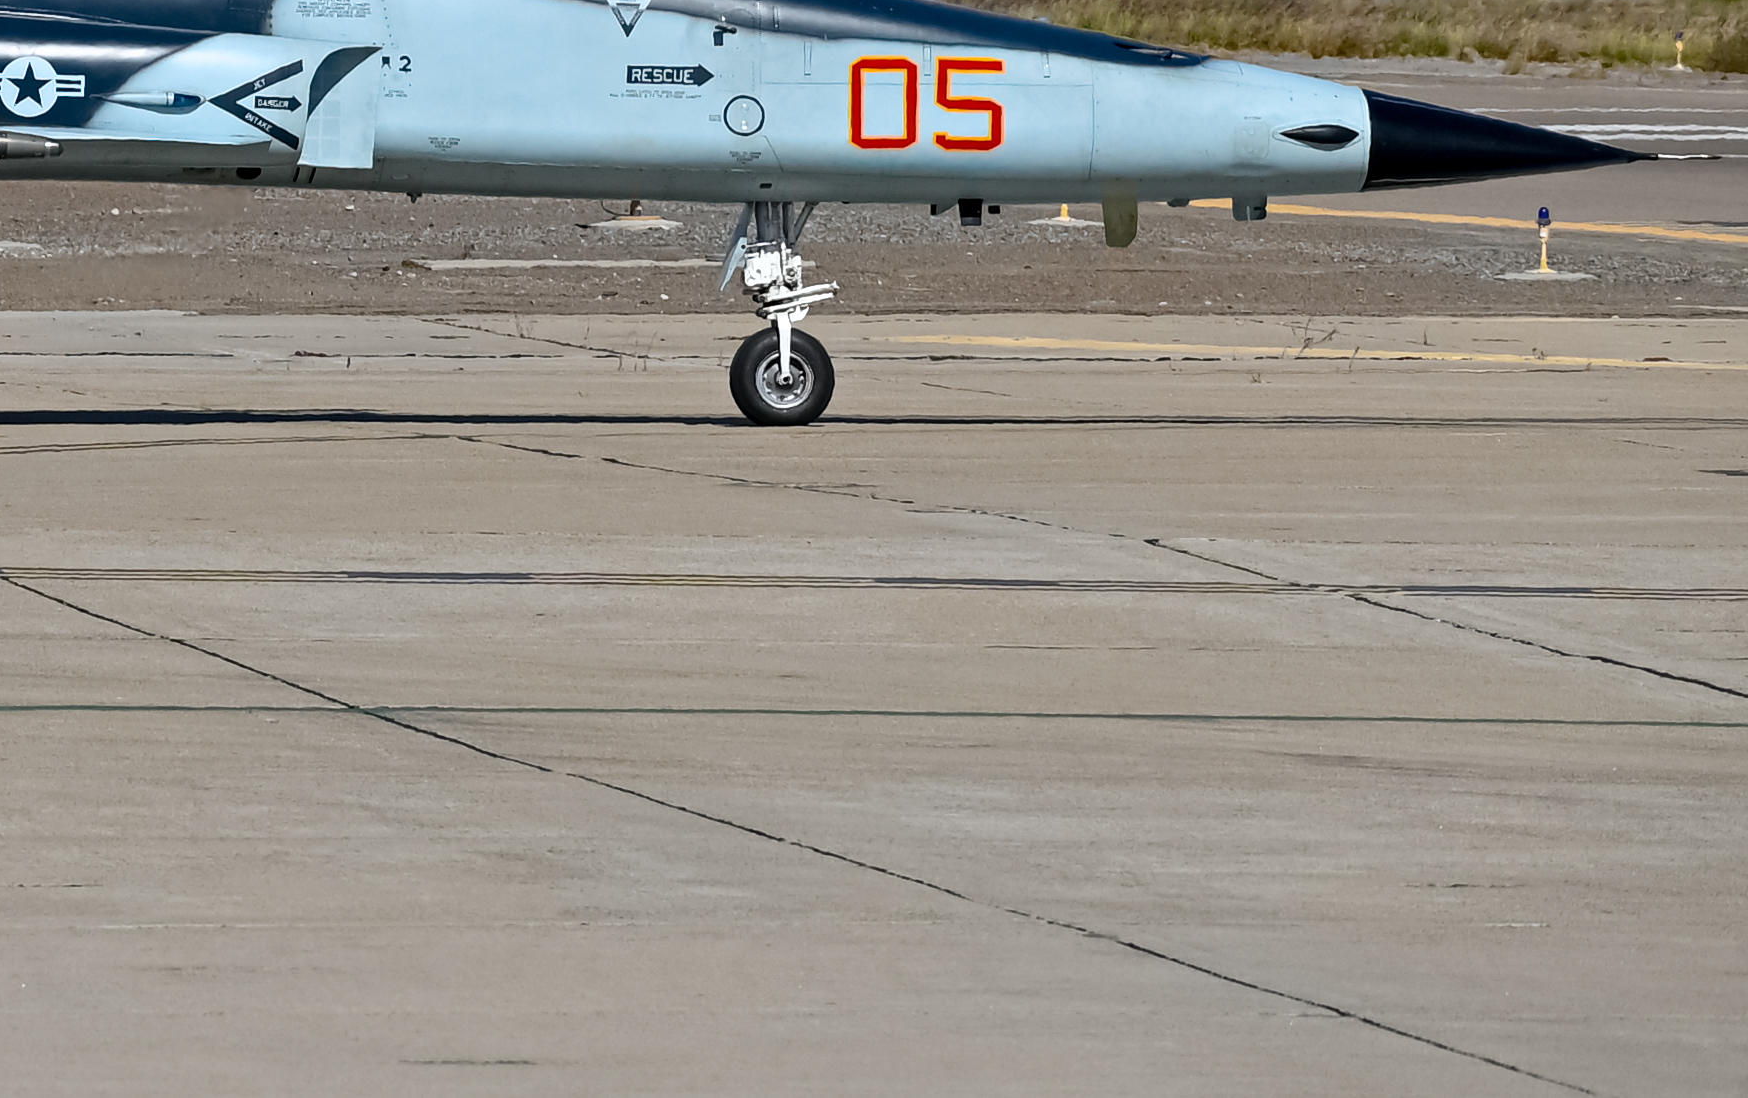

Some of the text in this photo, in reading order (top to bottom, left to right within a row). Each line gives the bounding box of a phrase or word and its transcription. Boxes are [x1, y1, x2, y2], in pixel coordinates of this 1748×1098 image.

[398, 55, 412, 73] 2
[631, 68, 695, 84] RESCUE
[848, 55, 1007, 152] 05
